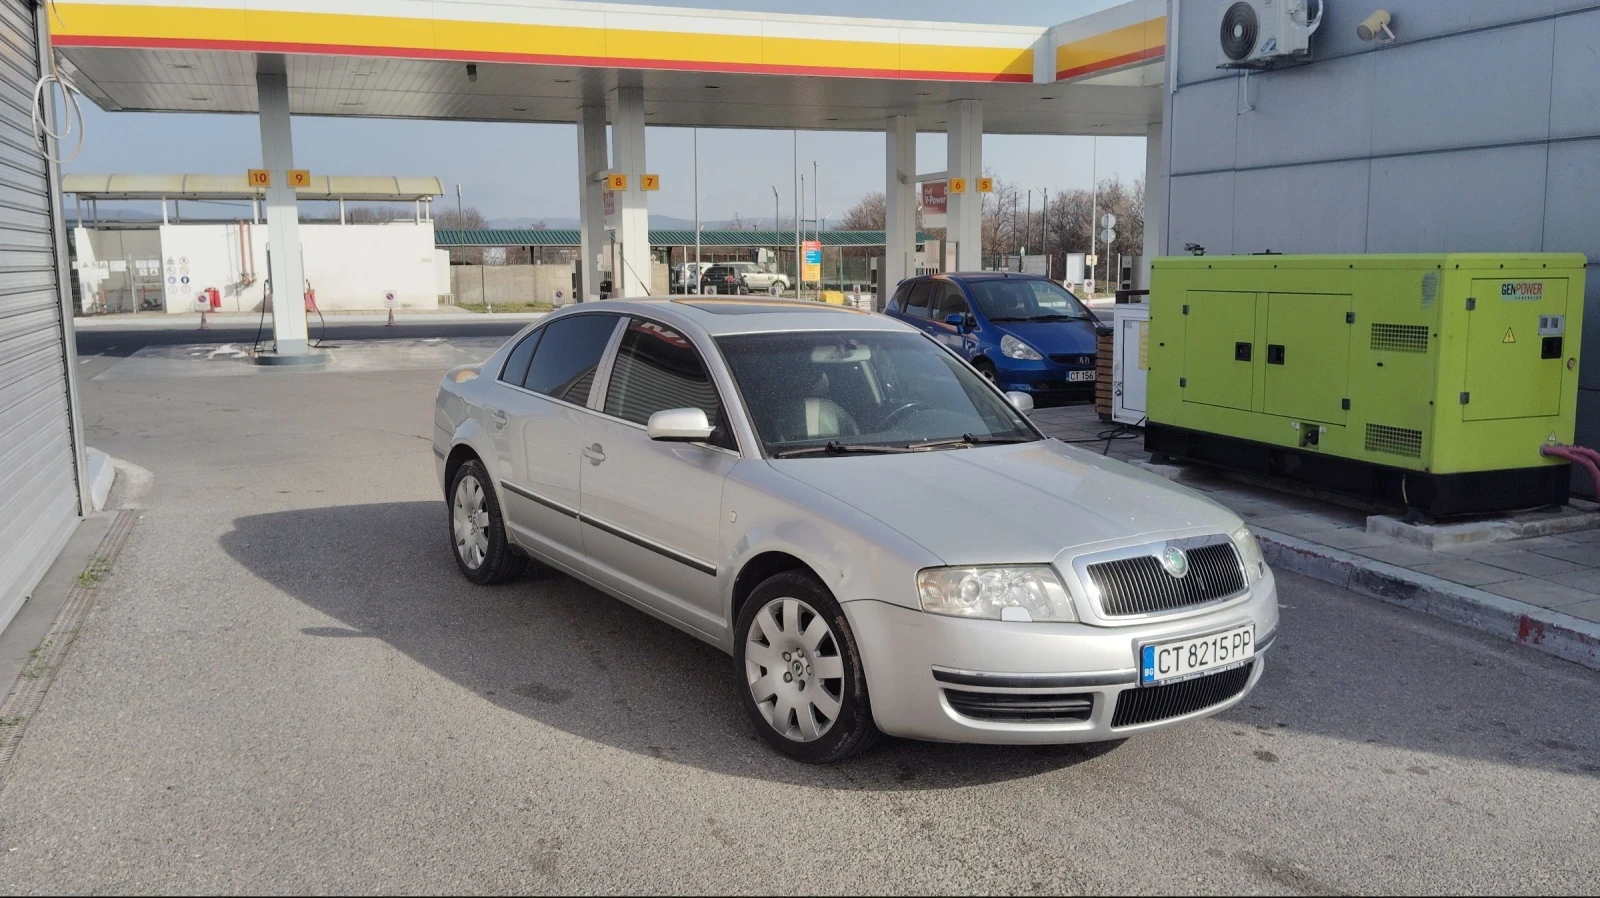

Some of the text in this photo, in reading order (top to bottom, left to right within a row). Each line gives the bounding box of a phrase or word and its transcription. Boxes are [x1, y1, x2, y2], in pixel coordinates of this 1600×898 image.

[254, 173, 267, 183] 10
[295, 174, 303, 184] 9
[615, 177, 622, 187] 8
[647, 177, 653, 187] 7
[955, 181, 962, 190] 6
[982, 181, 988, 190] 5
[924, 195, 947, 205] V-Power
[1070, 372, 1080, 380] CT
[1158, 645, 1184, 675] CT
[1188, 636, 1229, 668] 8215
[1232, 630, 1251, 658] PP
[1144, 668, 1153, 677] BG
